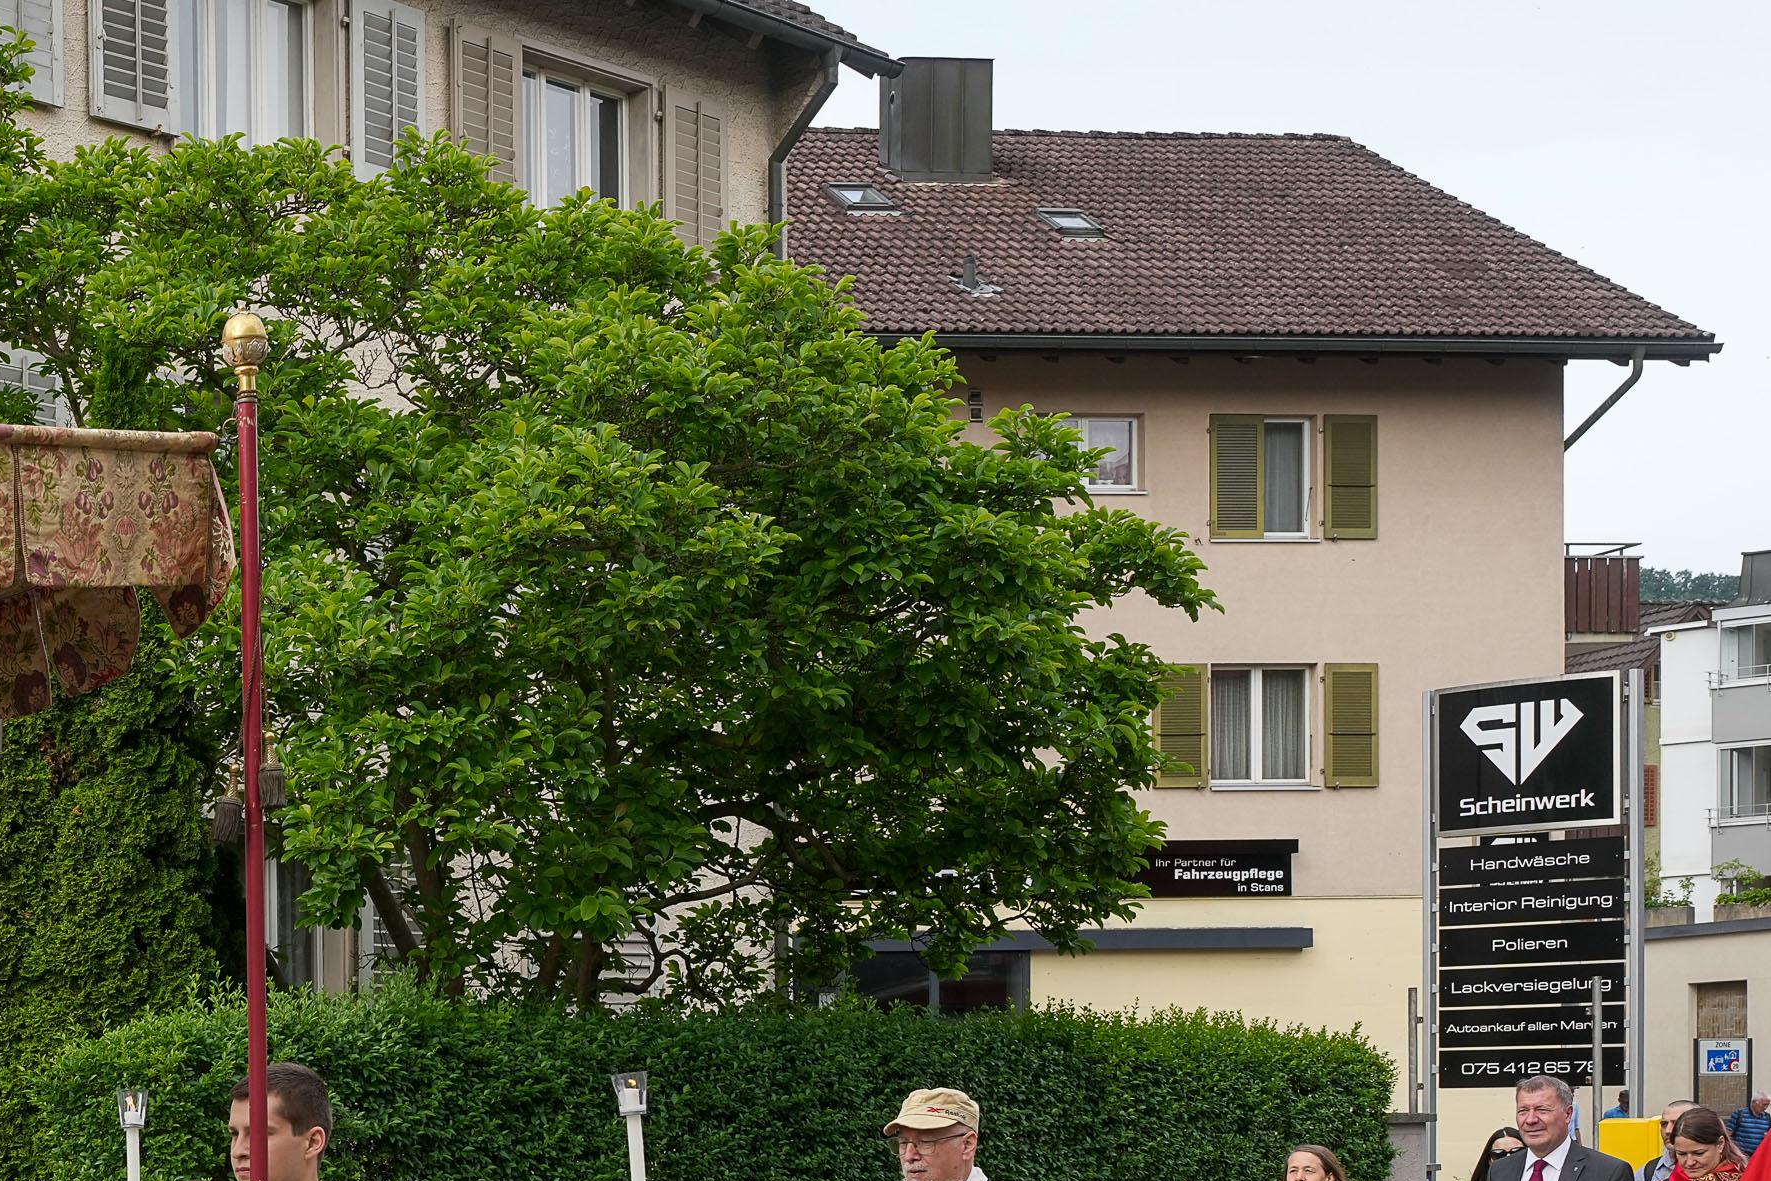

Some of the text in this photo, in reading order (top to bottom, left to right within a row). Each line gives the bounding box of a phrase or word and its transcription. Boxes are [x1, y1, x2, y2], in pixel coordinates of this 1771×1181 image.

[1460, 788, 1596, 816] Scheinwerk
[1155, 858, 1236, 867] Ihr Partner für
[1470, 852, 1590, 871] Handwäsche
[1174, 868, 1284, 881] Fahrzeugpflege
[1238, 883, 1284, 892] in Stans
[1449, 894, 1613, 913] Interior Reinigung
[1492, 938, 1568, 952] Polieren
[1446, 1020, 1616, 1034] Autoankauf aller Maren
[1461, 1062, 1499, 1075] 075
[1503, 1062, 1541, 1075] 412
[1544, 1062, 1570, 1074] 65
